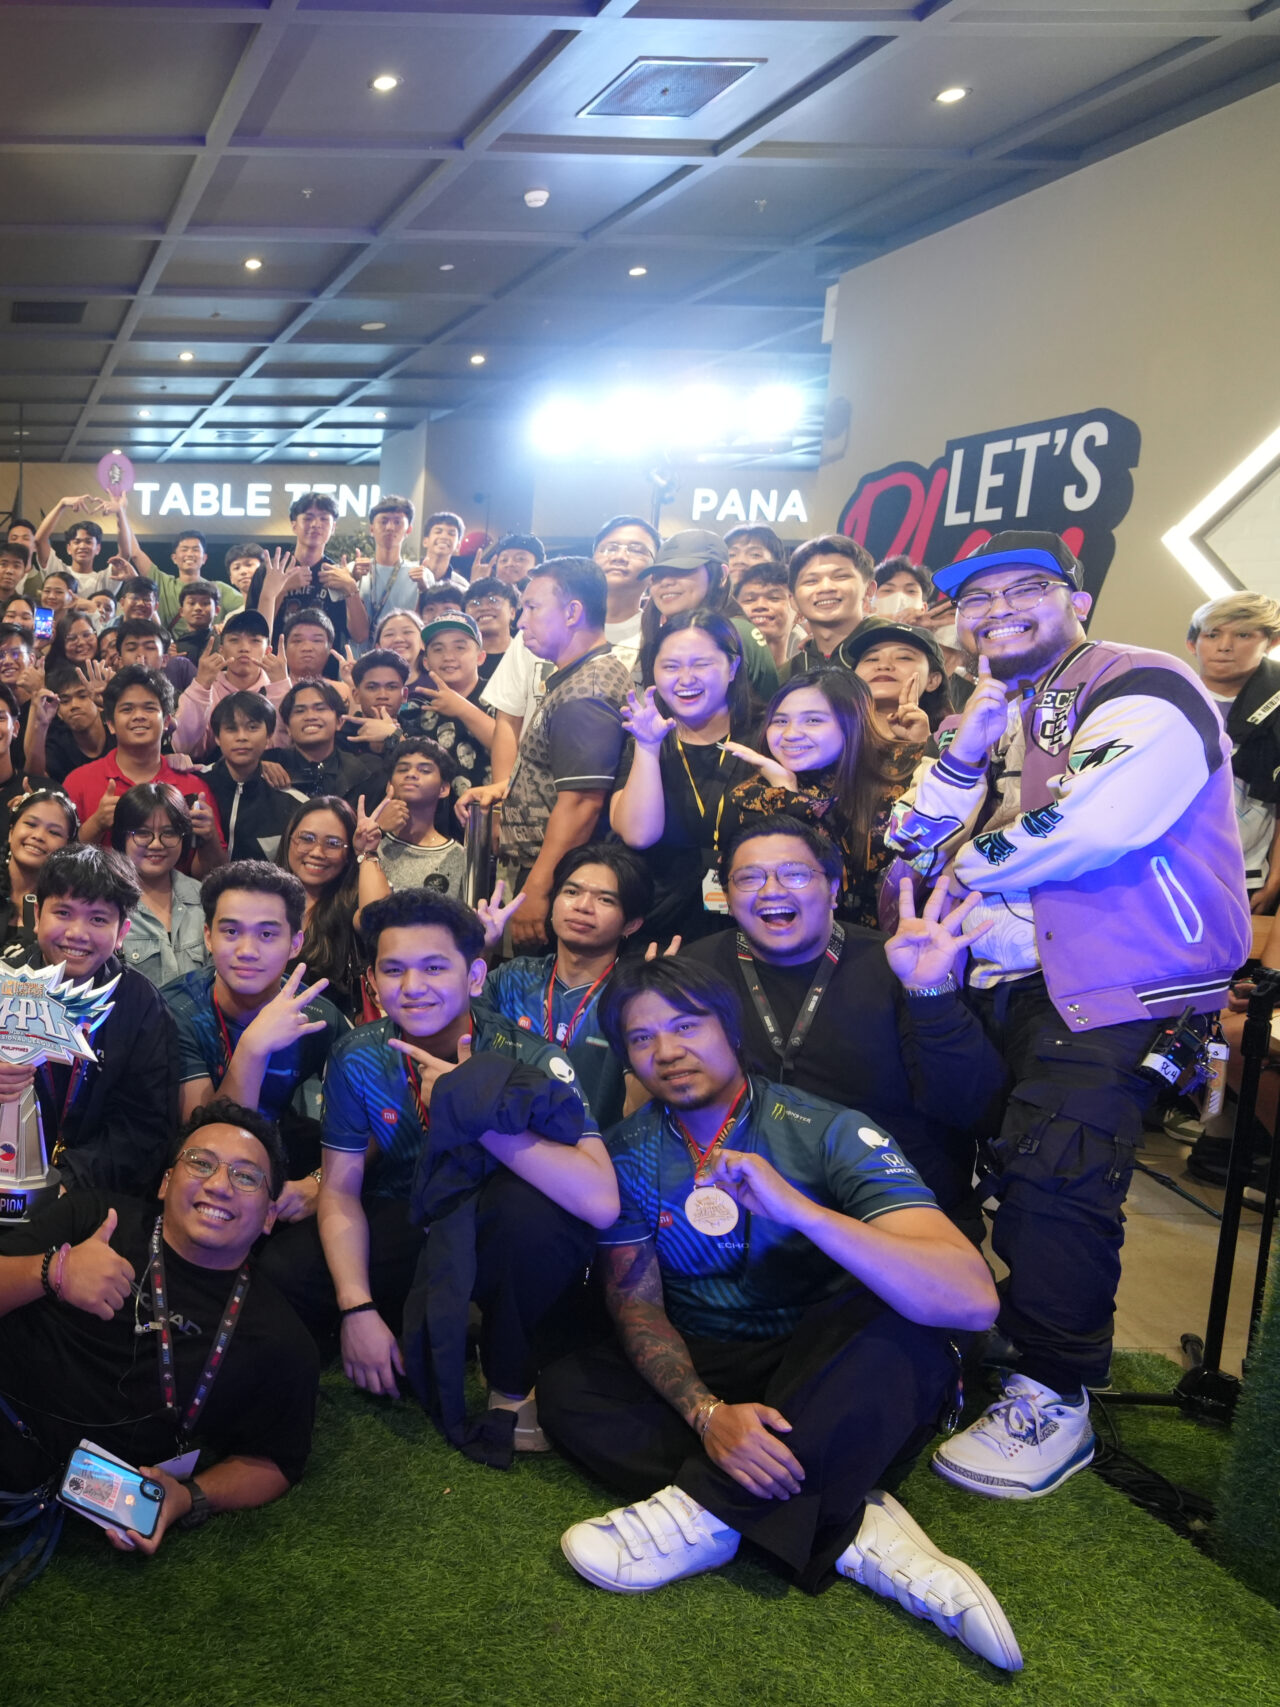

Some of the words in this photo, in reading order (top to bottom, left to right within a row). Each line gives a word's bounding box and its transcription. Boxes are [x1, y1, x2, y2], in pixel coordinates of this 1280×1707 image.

[944, 421, 1109, 527] LET'S
[133, 482, 272, 517] TABLE
[692, 487, 808, 522] PANA
